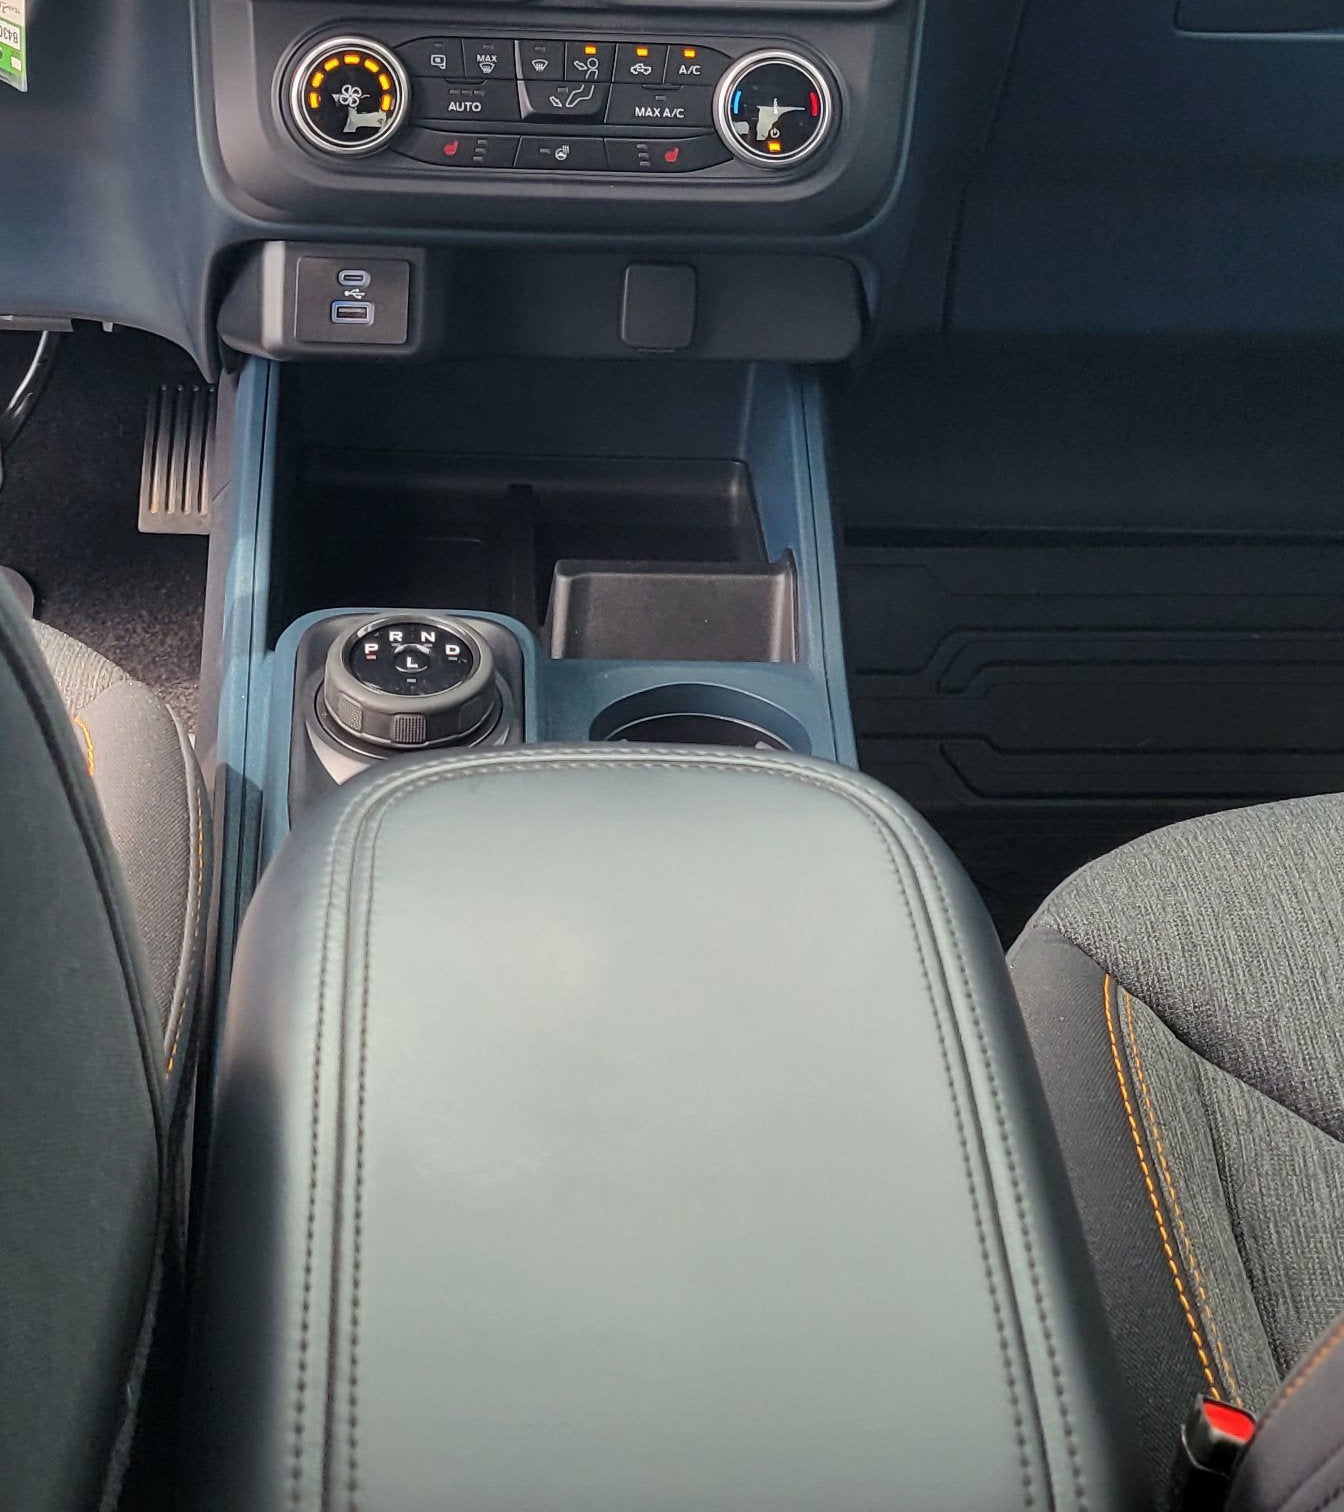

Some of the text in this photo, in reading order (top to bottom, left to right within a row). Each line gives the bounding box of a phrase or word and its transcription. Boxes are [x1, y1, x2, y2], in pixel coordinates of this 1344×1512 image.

[477, 54, 497, 63] MAX
[679, 64, 701, 76] A/C
[448, 101, 482, 113] AUTO
[635, 106, 685, 119] MAX A/C
[389, 631, 403, 642] R
[420, 631, 436, 642] N
[364, 644, 379, 655] P
[445, 645, 461, 655] D
[406, 656, 419, 669] L
